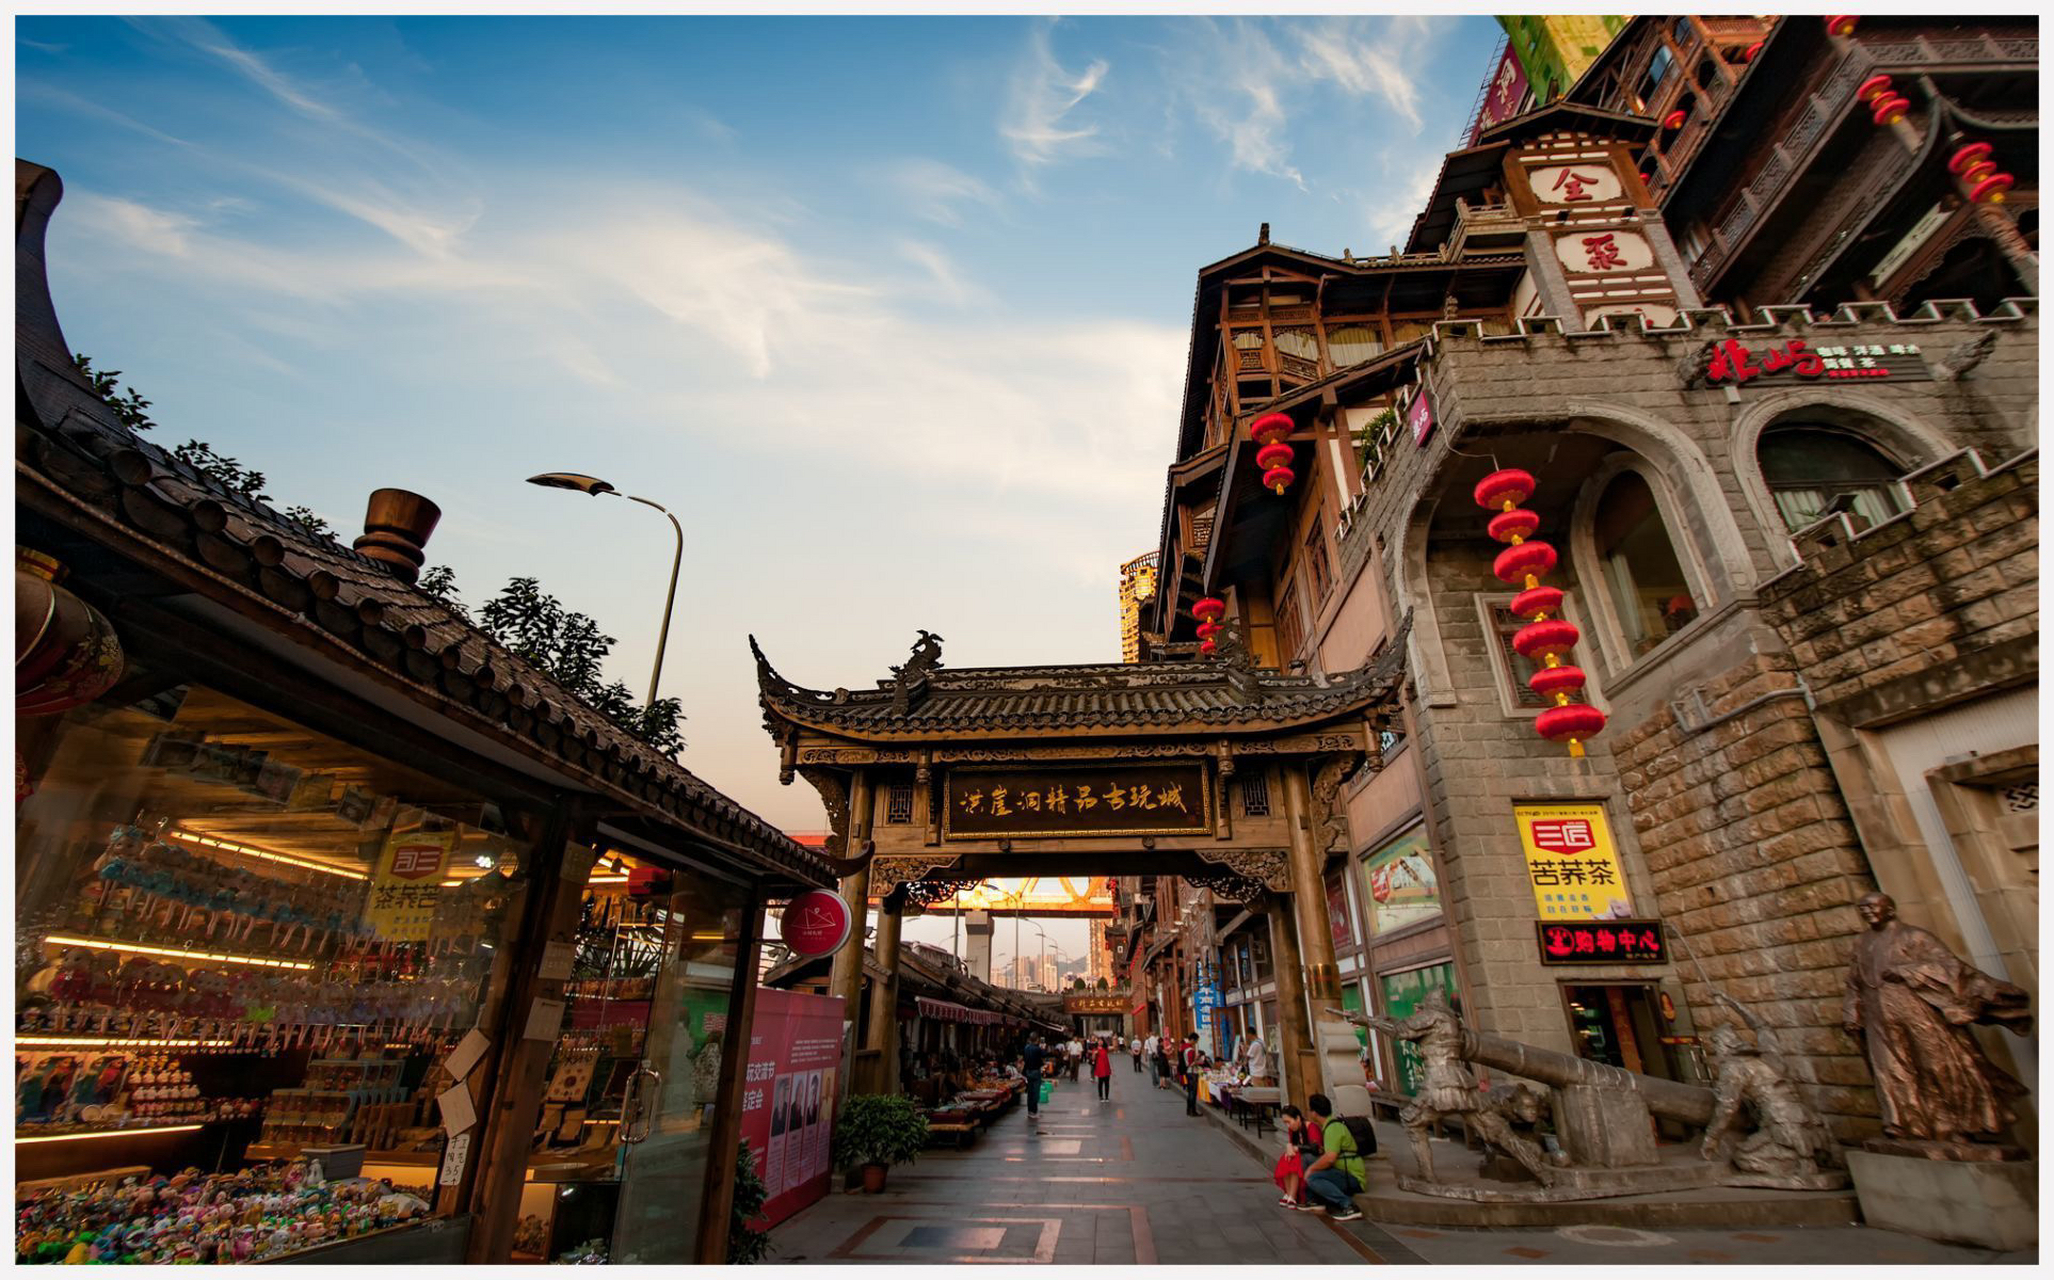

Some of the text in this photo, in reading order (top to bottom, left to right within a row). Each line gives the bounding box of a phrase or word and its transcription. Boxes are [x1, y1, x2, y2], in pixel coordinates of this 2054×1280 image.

[959, 781, 1188, 816] 洪崖洞精品古玩城
[1535, 825, 1592, 846] 三匠
[1530, 859, 1615, 886] 苦荞茶
[1575, 929, 1660, 953] 购物中心
